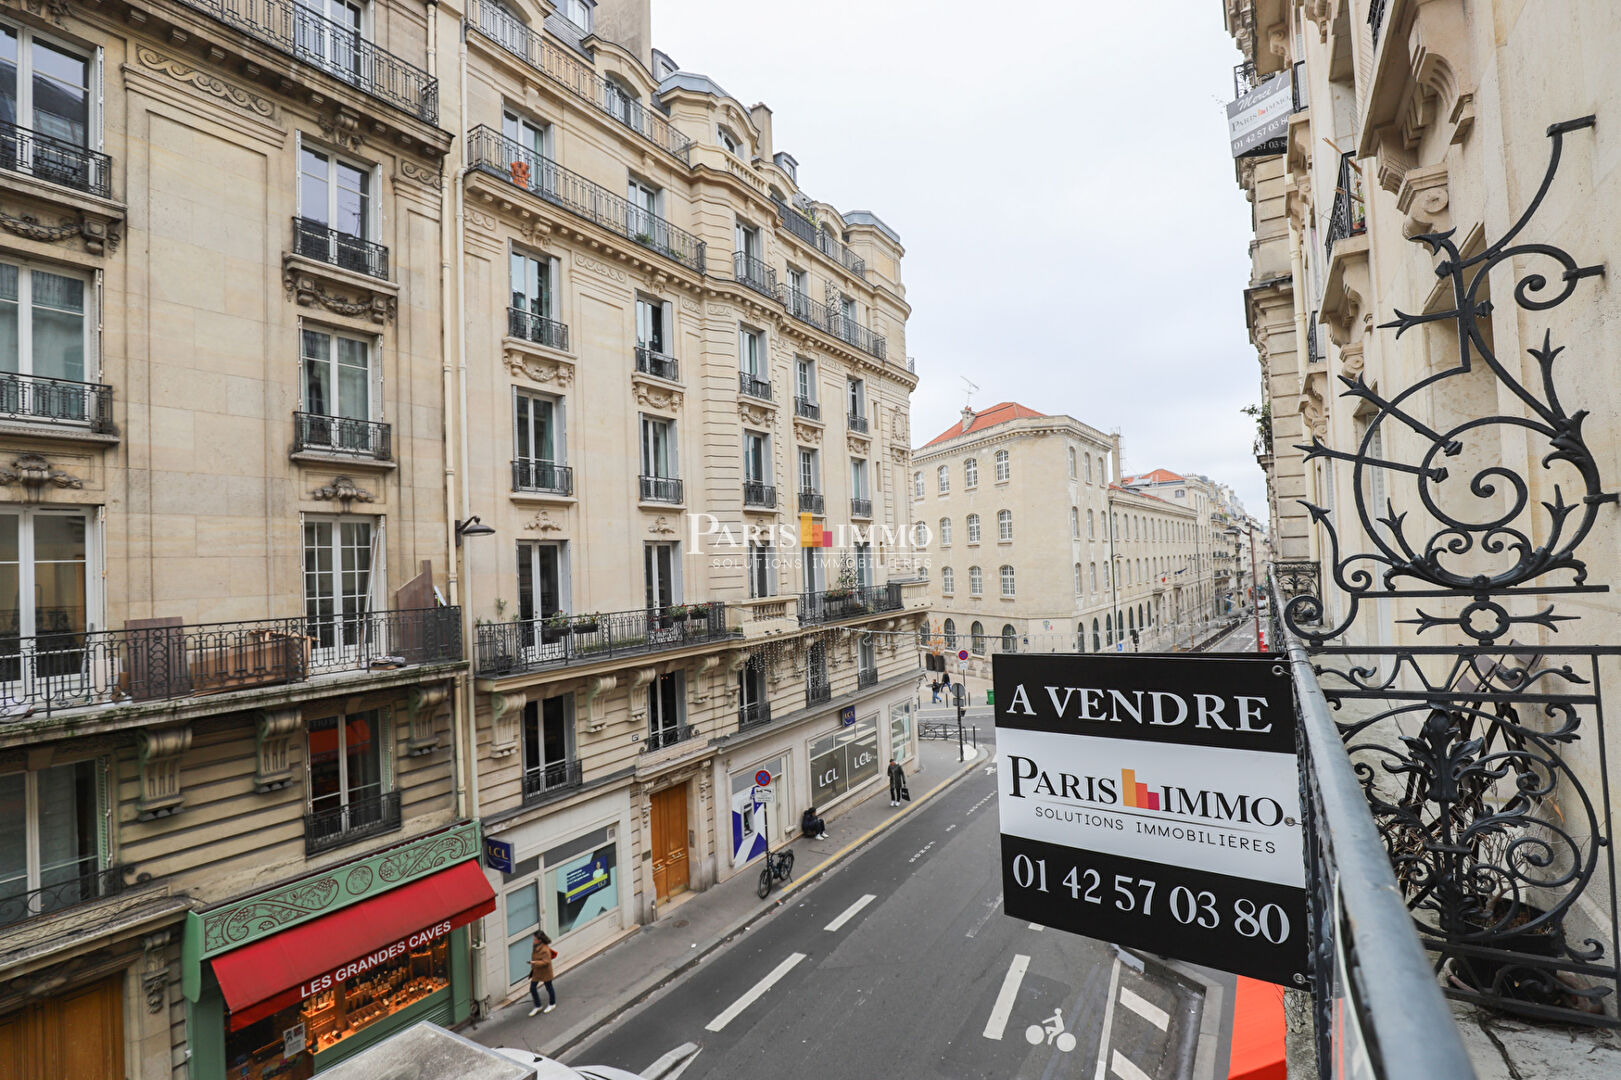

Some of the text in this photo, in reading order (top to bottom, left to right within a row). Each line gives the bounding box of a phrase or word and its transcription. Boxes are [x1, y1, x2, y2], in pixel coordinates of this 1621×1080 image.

[1234, 140, 1244, 150] 01
[1246, 134, 1256, 144] 42
[1257, 127, 1267, 138] 57
[1268, 120, 1280, 131] 03
[844, 710, 854, 719] LCL
[1006, 684, 1273, 733] A VENDRE
[819, 768, 838, 788] LCL
[854, 752, 871, 768] LCL
[1007, 755, 1118, 805] PARIS
[1160, 785, 1284, 827] IMMO
[1035, 806, 1276, 854] SOLUTIONS IMMOBILIÈRES
[488, 845, 508, 860] LCL
[1012, 854, 1290, 944] 01 42 57 03 80
[301, 920, 452, 998] LES GRANDES CAVES
